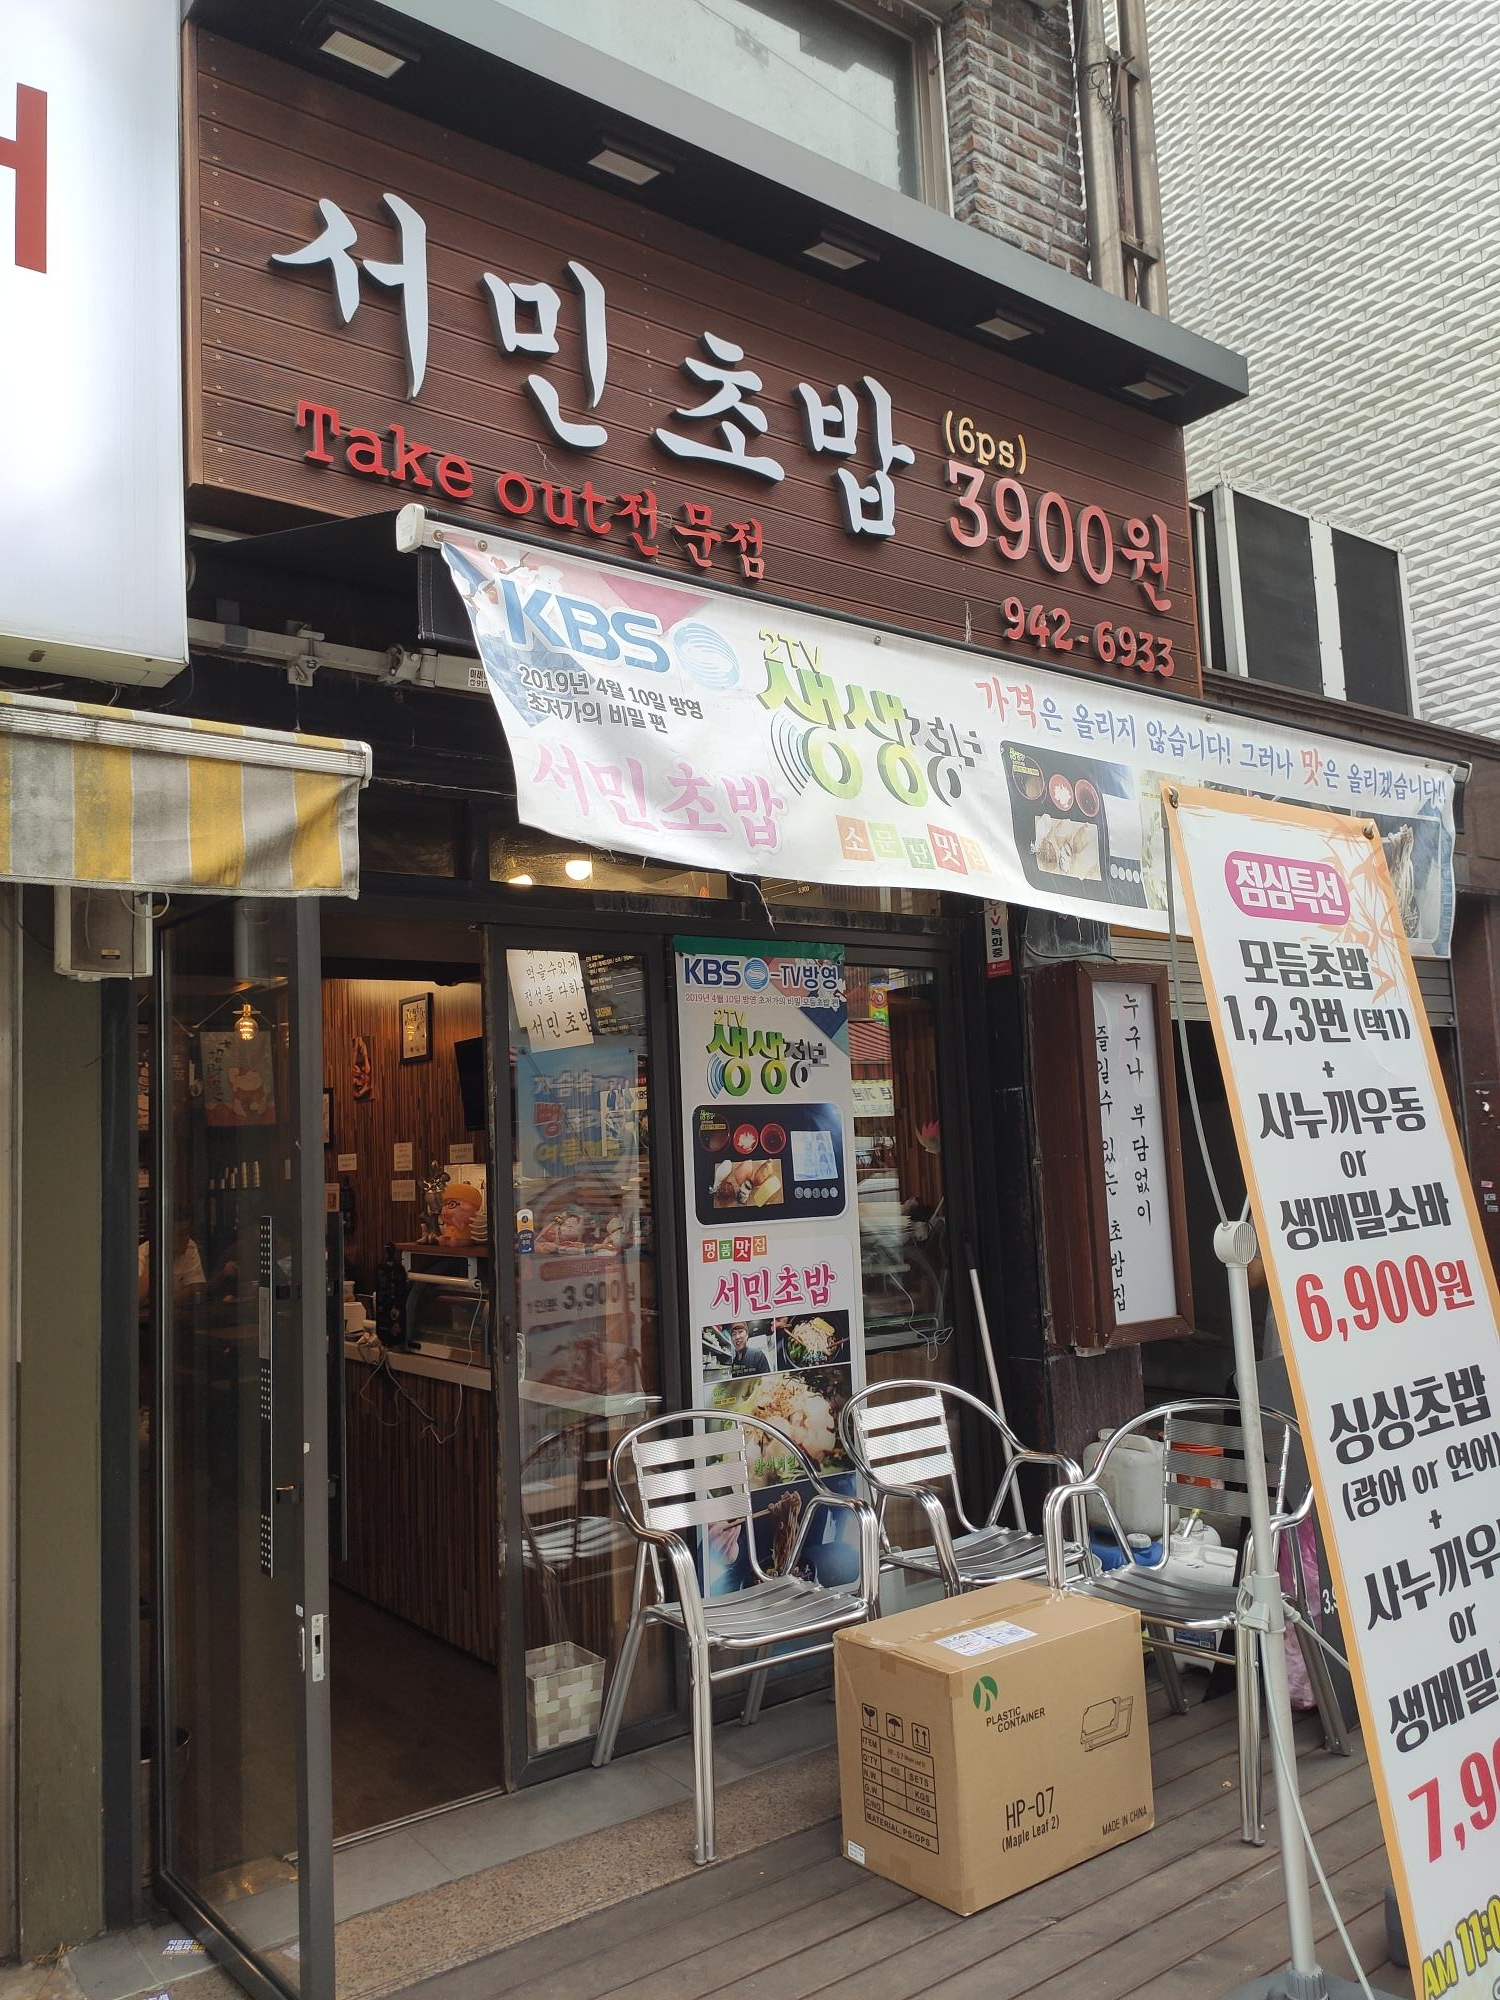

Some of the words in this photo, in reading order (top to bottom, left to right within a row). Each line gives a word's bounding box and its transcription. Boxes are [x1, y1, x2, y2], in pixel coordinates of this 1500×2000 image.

[271, 192, 916, 537] 서민초밥
[296, 399, 474, 499] Take
[943, 410, 1027, 475] (6ps)
[946, 459, 1172, 612] 3900원
[499, 578, 672, 674] KBS
[758, 628, 822, 674] 2TV
[1002, 596, 1175, 677] 942-6933
[520, 665, 589, 695] 2019년
[597, 677, 625, 700] 4월
[629, 686, 667, 711] 10일
[669, 696, 704, 719] 방영
[528, 692, 602, 725] 초저가의
[610, 702, 644, 728] 비밀
[649, 712, 668, 733] 편
[975, 676, 1063, 730] 가격은
[1073, 703, 1136, 748] 올리지
[1147, 719, 1231, 766] 않습니다!
[1240, 741, 1293, 779] 그러나
[1300, 748, 1341, 785] 맛은
[532, 743, 785, 849] 서민초밥
[1231, 858, 1345, 917] 점심특선
[684, 957, 741, 986] KBS
[1238, 938, 1374, 991] 모듬초밥
[525, 985, 554, 1007] 정성을
[558, 979, 585, 998] 다하
[685, 993, 710, 1002] 2019년
[711, 994, 724, 1004] 4월
[742, 995, 757, 1005] 방영
[713, 1008, 745, 1028] 2TV
[1223, 994, 1351, 1046] 1,2,3번
[1353, 1007, 1411, 1041] (택1)
[706, 1023, 830, 1097] 생생정보
[1123, 993, 1145, 1083] 누구나
[1257, 1086, 1427, 1140] 사누끼우동
[1101, 1136, 1119, 1196] 있는
[1130, 1103, 1151, 1228] 부담없이
[1339, 1149, 1368, 1179] or
[1279, 1181, 1452, 1251] 생메밀소바
[702, 1235, 767, 1261] 명품맛집
[1109, 1219, 1126, 1312] 초밥집
[711, 1263, 836, 1316] 서민초밥
[1295, 1254, 1476, 1343] 6,900원
[1328, 1363, 1492, 1466] 싱싱초밥
[1342, 1464, 1407, 1522] (광어
[1412, 1459, 1439, 1495] or
[1364, 1518, 1500, 1631] 사누끼우
[1449, 1602, 1477, 1644] or
[985, 1706, 1021, 1728] PLASTIC
[997, 1707, 1046, 1733] CONTAINER
[1388, 1647, 1500, 1754] 생메밀
[862, 1736, 878, 1749] ITEM
[864, 1783, 879, 1796] G.W.
[915, 1805, 932, 1818] KGS
[908, 1772, 930, 1788] SETS
[914, 1790, 931, 1803] KGS
[1407, 1736, 1500, 1864] 7,9
[1001, 1829, 1031, 1853] (Maple
[1032, 1820, 1050, 1838] Leaf
[1051, 1813, 1060, 1831] 2)
[1005, 1785, 1055, 1832] HP-07
[1102, 1819, 1121, 1837] MADE
[1122, 1814, 1129, 1827] IN
[1130, 1805, 1148, 1823] CHINA
[1421, 1944, 1459, 2000] AM
